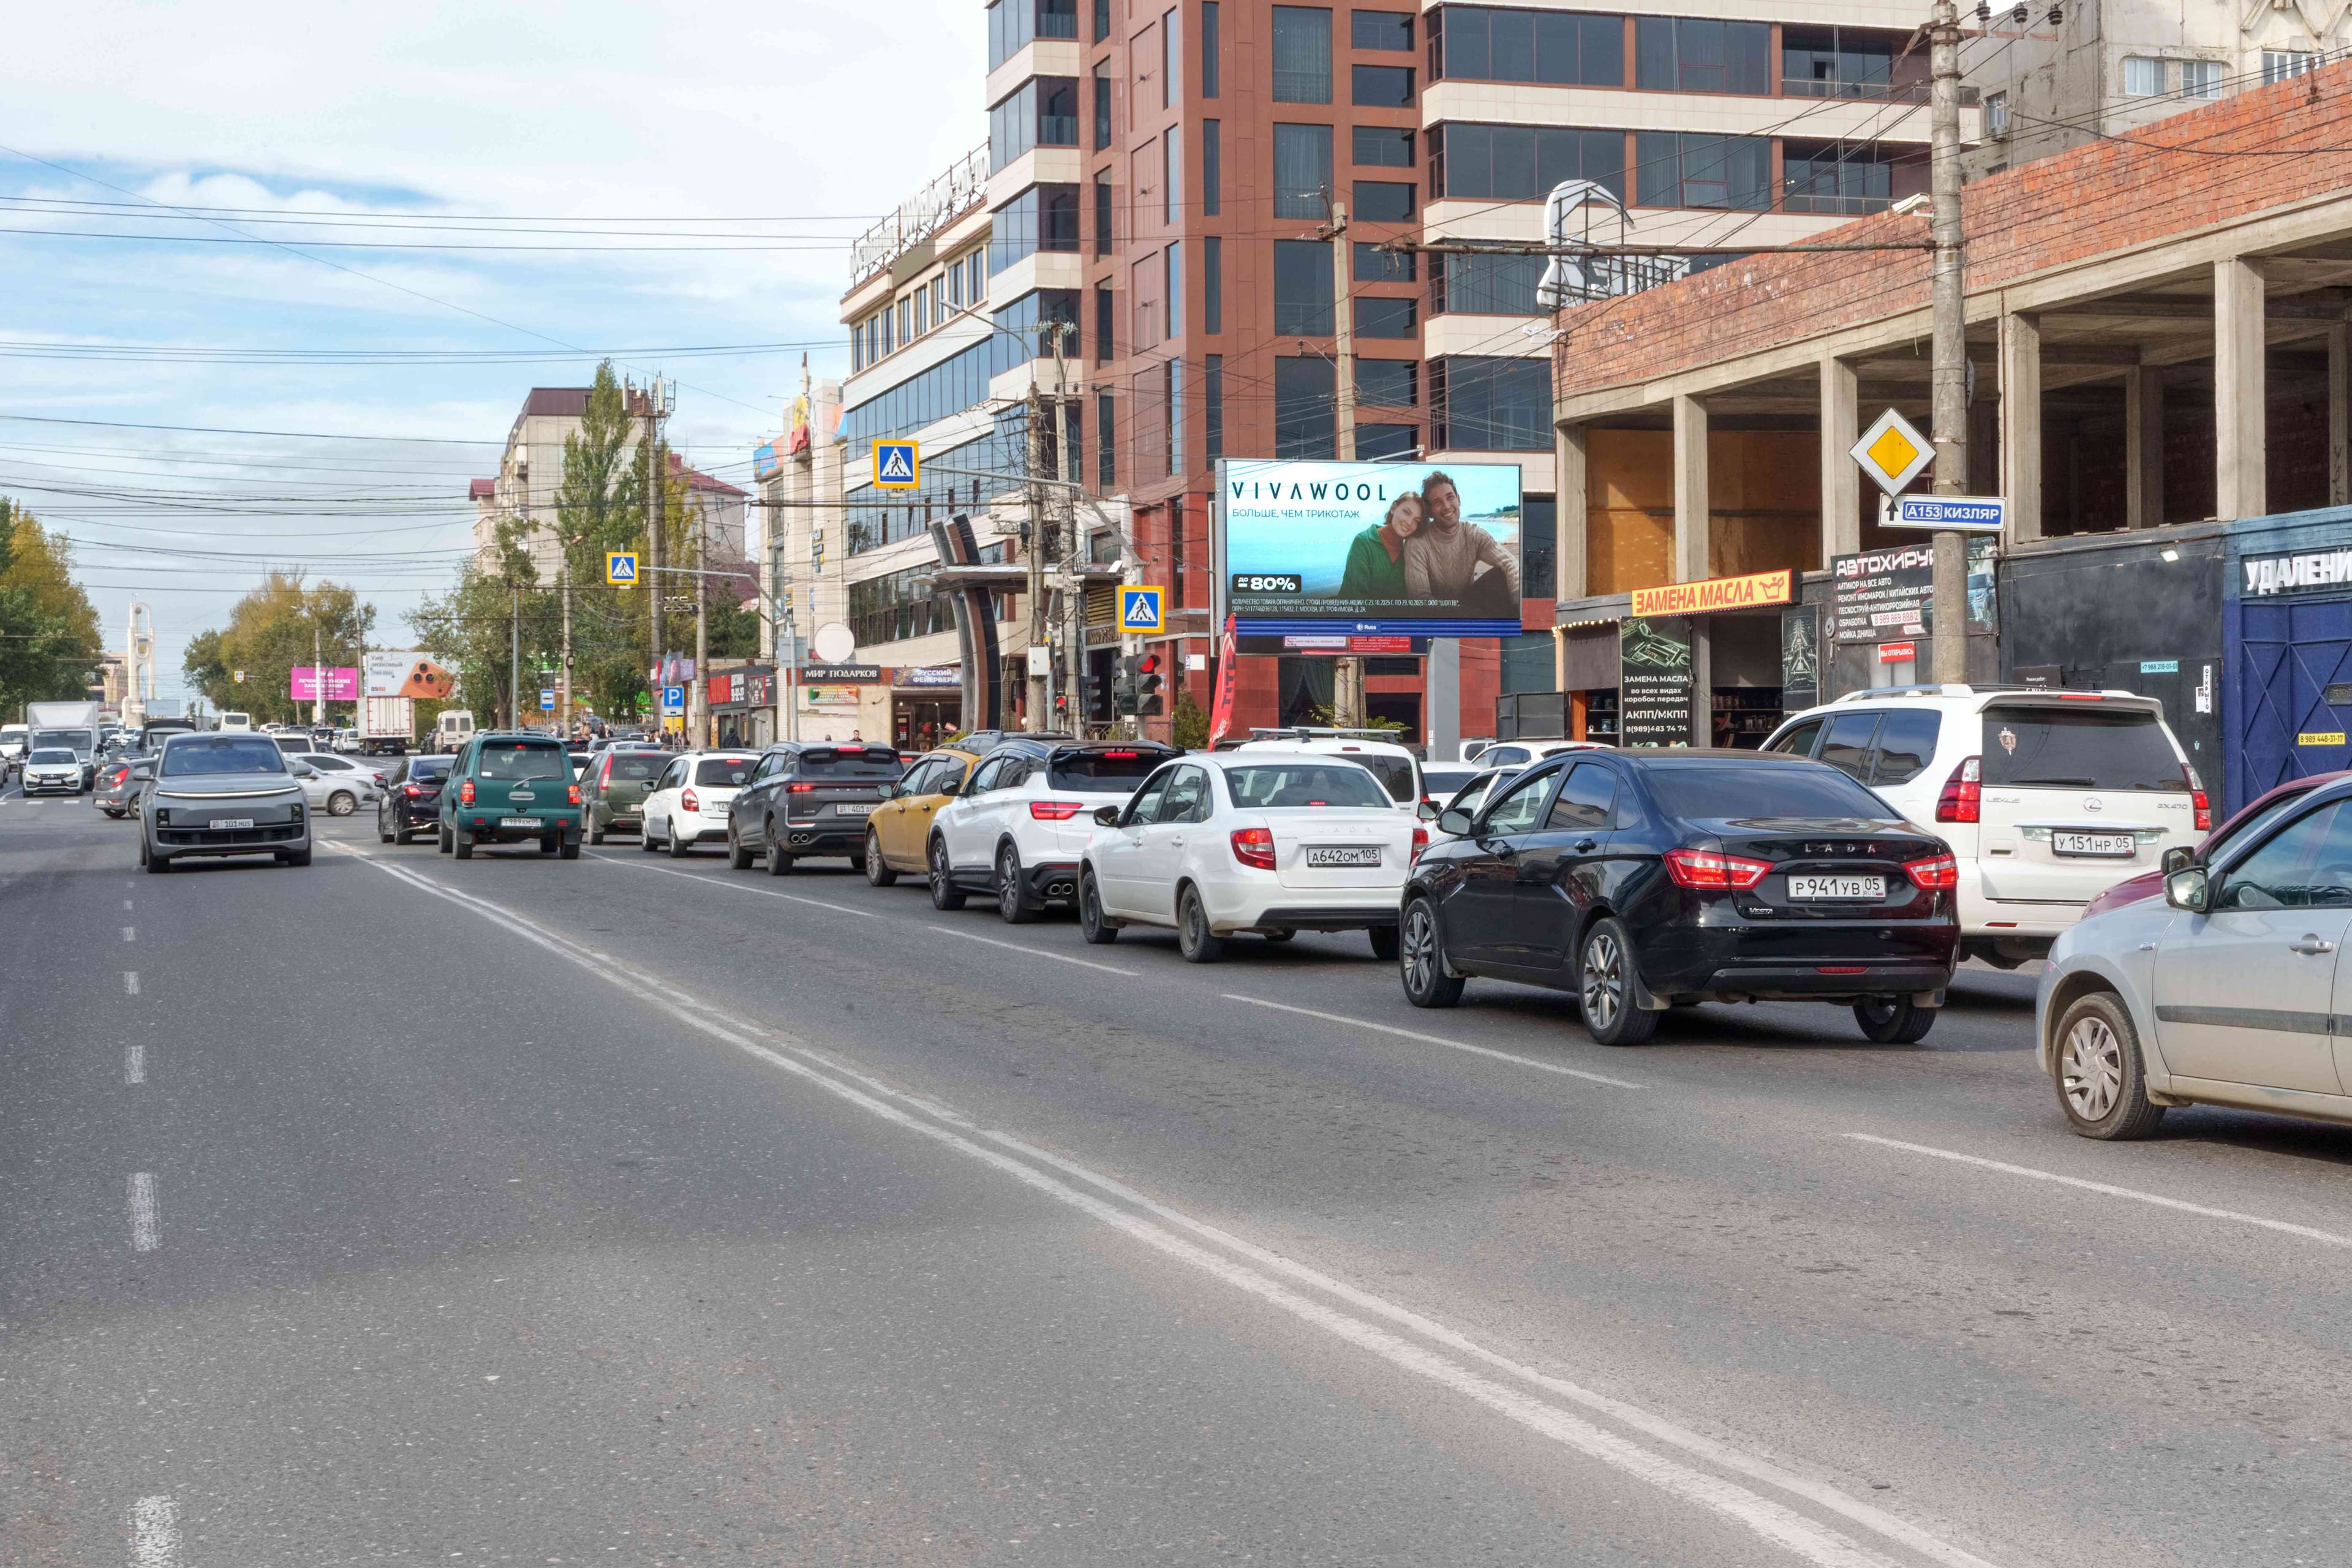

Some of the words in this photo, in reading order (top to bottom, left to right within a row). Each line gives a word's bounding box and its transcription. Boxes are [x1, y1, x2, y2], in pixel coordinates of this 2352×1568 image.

[1232, 482, 1386, 500] VIVAWOOL
[1232, 509, 1279, 518] БОЛЬШЕ,
[1306, 510, 1360, 518] ТРИКОТАЖ
[1907, 505, 1940, 518] А153
[1944, 507, 1999, 520] КИЗЛЯР
[1838, 581, 1859, 590] АНТИКОР
[1868, 579, 1877, 587] ВСЕ
[1878, 578, 1891, 586] АВТО
[1636, 587, 1696, 613] ЗАМЕНА
[1700, 579, 1754, 607] МАСЛА
[1838, 594, 1856, 603] РЕМОНТ
[1857, 592, 1885, 601] ИНОМАРОК
[1890, 587, 1919, 598] КИТАЙСКИХ
[1920, 586, 1933, 595] АВТО
[1839, 599, 1920, 615] ПЕСКОСТРУЙ-АНТИКОРРОЗИЙНАЯ
[1839, 617, 1867, 627] ОБРАБОТКА
[1879, 614, 1890, 623] 989
[1839, 629, 1856, 639] МОЙКА
[1857, 629, 1876, 639] ДНИЩА
[805, 669, 826, 678] МИР
[829, 669, 878, 678] ПОДАРКОВ
[1626, 709, 1687, 720] АКПП/МКПП
[1805, 844, 1875, 853] LADA
[2058, 836, 2111, 851] У151НР
[2116, 837, 2129, 848] 05
[1312, 850, 1359, 862] А642ОМ
[1360, 850, 1377, 859] 105
[1796, 878, 1860, 895] Р941УВ
[1864, 878, 1880, 890] 05
